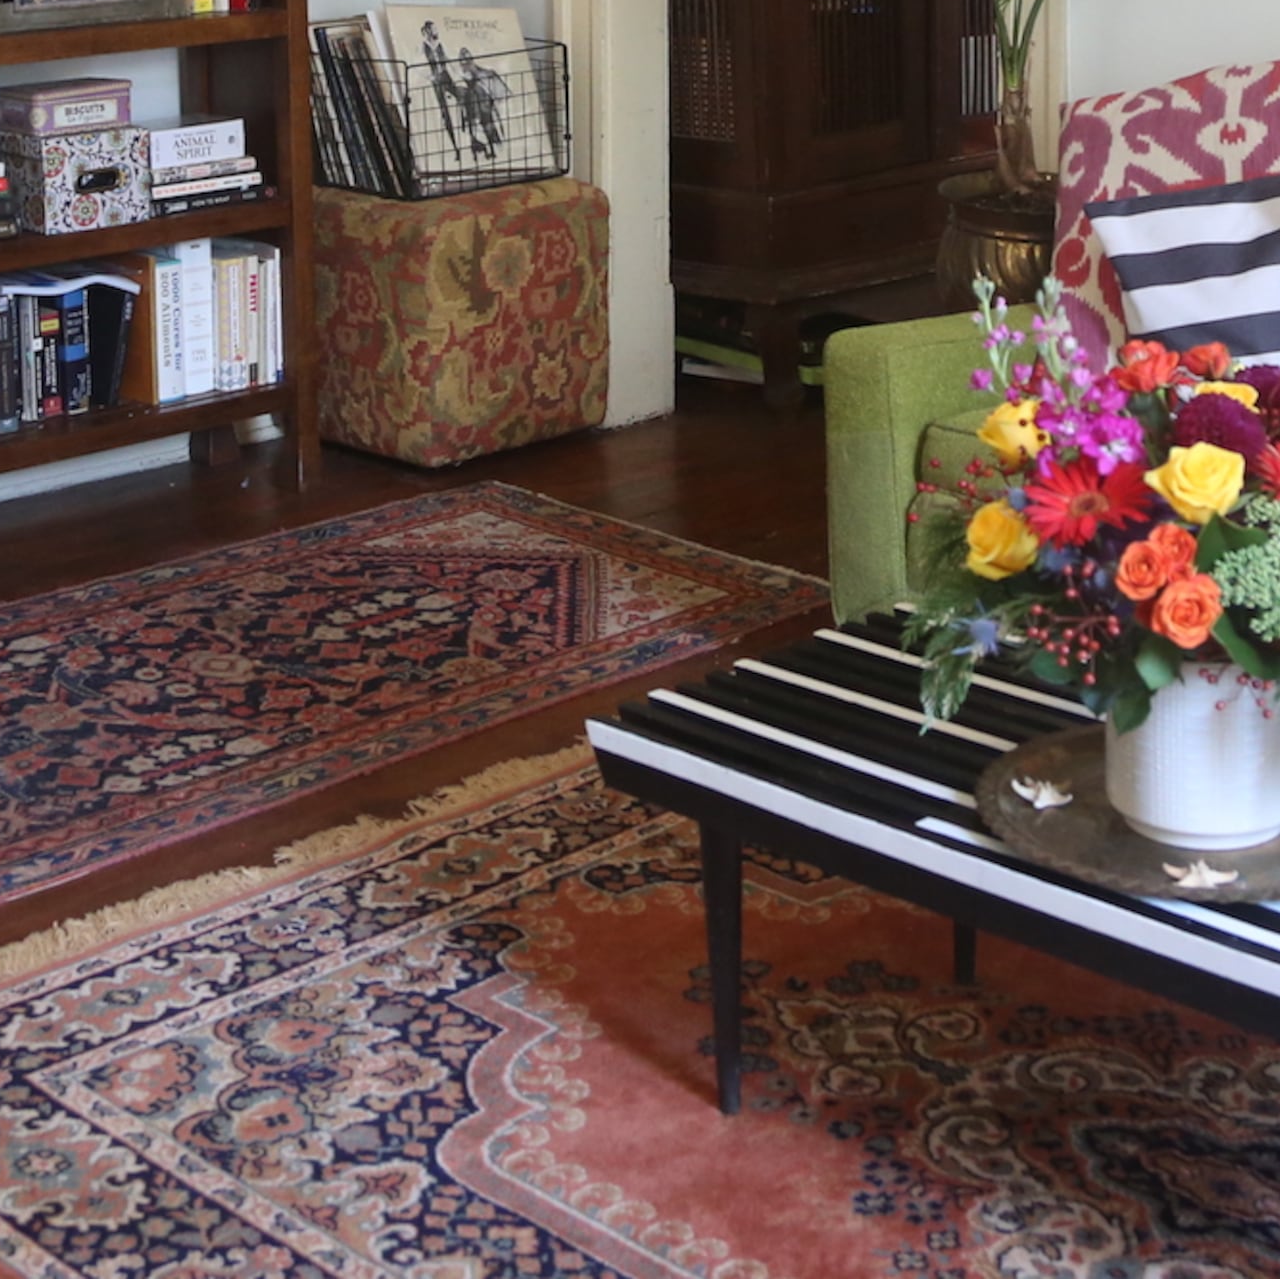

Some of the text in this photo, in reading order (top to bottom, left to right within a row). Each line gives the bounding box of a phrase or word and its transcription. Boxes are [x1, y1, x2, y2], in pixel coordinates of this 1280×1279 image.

[65, 104, 105, 117] BISCUITS
[174, 134, 217, 150] ANIMAL
[177, 146, 212, 160] SPIRIT
[249, 274, 258, 314] PRETTY
[160, 272, 172, 368] 200 Ailments
[171, 271, 183, 372] 1000 Cures for
